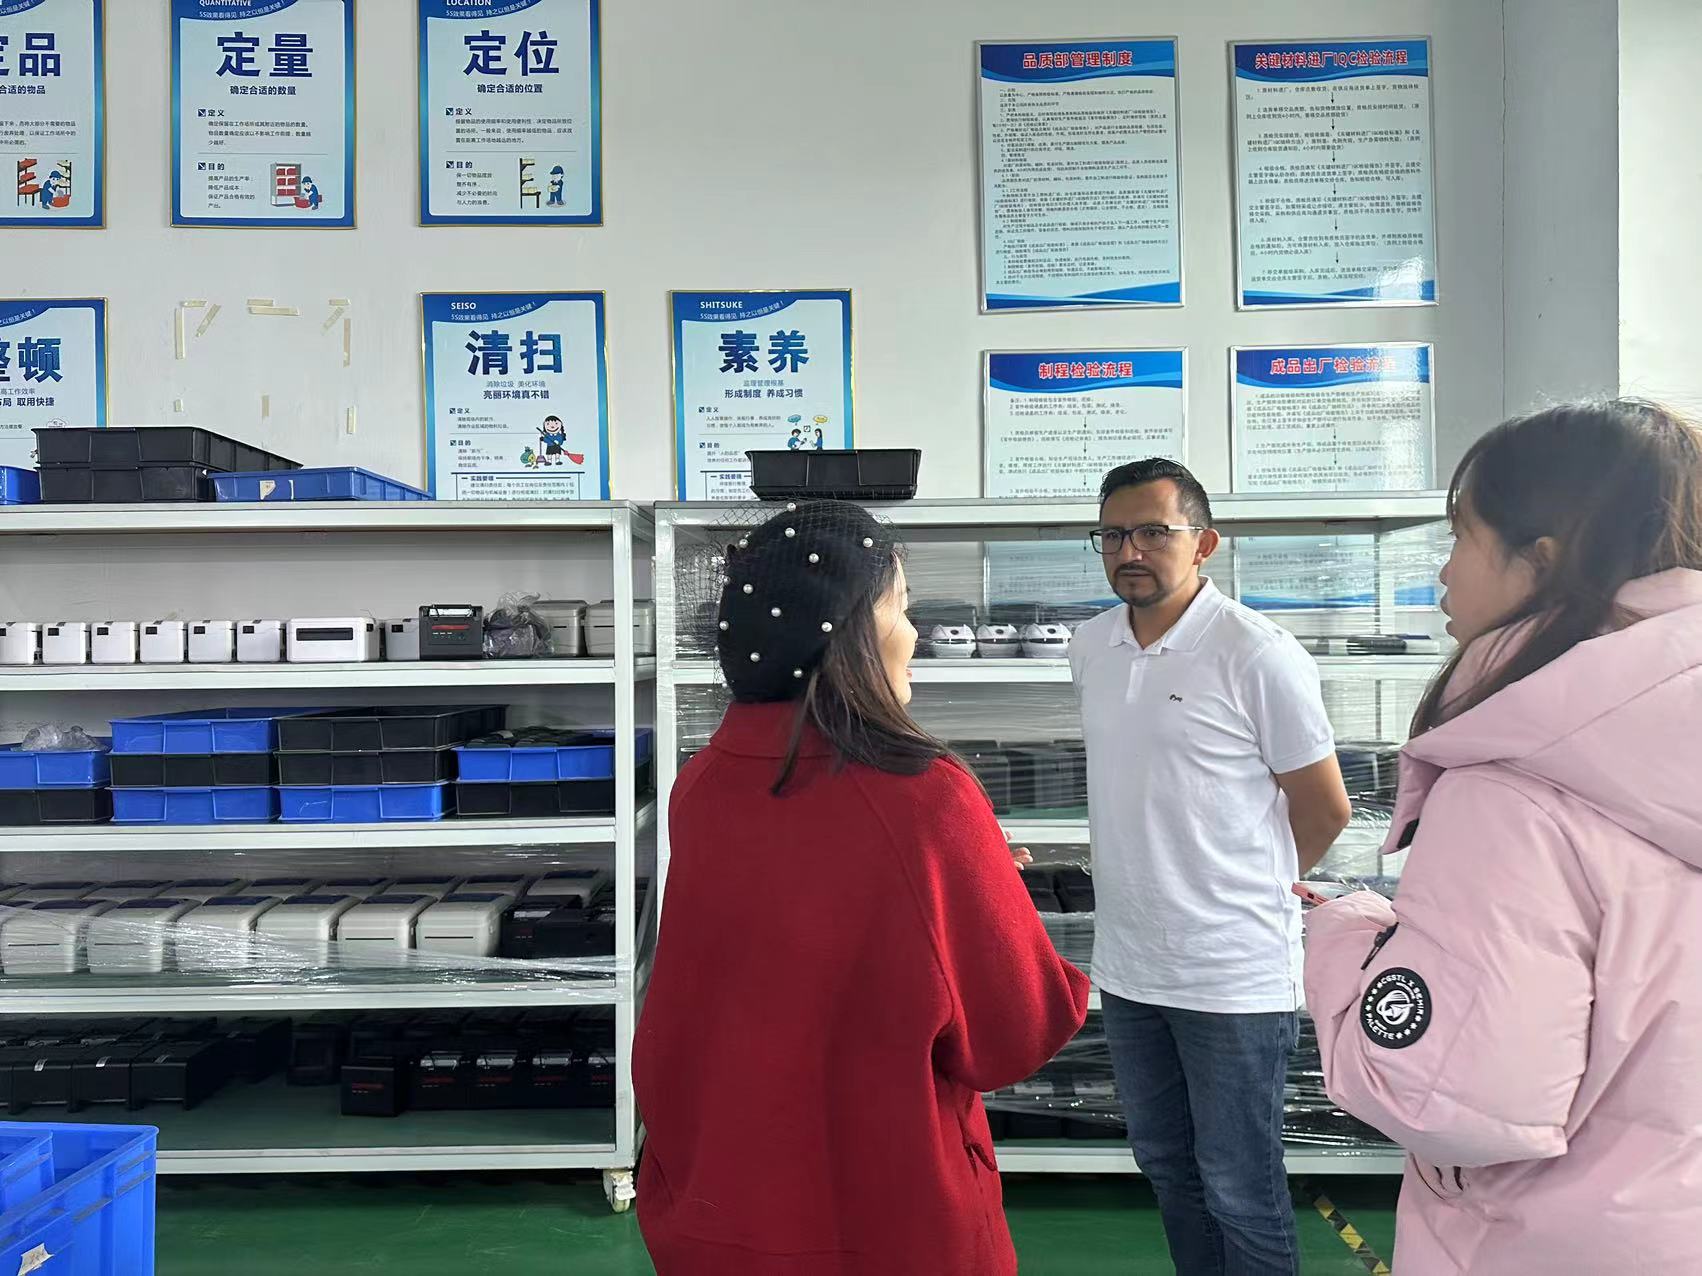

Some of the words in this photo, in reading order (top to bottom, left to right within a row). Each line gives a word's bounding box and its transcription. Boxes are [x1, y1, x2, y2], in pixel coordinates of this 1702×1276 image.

[0, 32, 61, 77] 品
[216, 31, 314, 78] 定量
[462, 30, 560, 77] 定位
[1022, 50, 1134, 69] 品质部管理制度
[1255, 49, 1409, 70] 关键材料进厂IQC检验流程
[229, 85, 297, 96] 确定合适的数量
[476, 84, 544, 94] 确定合适的位置
[451, 302, 477, 310] SEISO
[700, 301, 743, 309] SHITSUKE
[0, 336, 63, 384] 顿
[465, 329, 564, 376] 清扫
[718, 330, 810, 374] 素养
[1039, 361, 1134, 379] 制程检验流程
[0, 387, 36, 396] 高工作效率
[483, 390, 550, 400] 亮丽环境真不错
[724, 389, 762, 398] 形成制度
[766, 388, 804, 398] 养成习惯
[17, 397, 55, 407] 取用快捷
[1381, 974, 1407, 985] CGSTL
[1365, 1012, 1395, 1040] PALETTE
